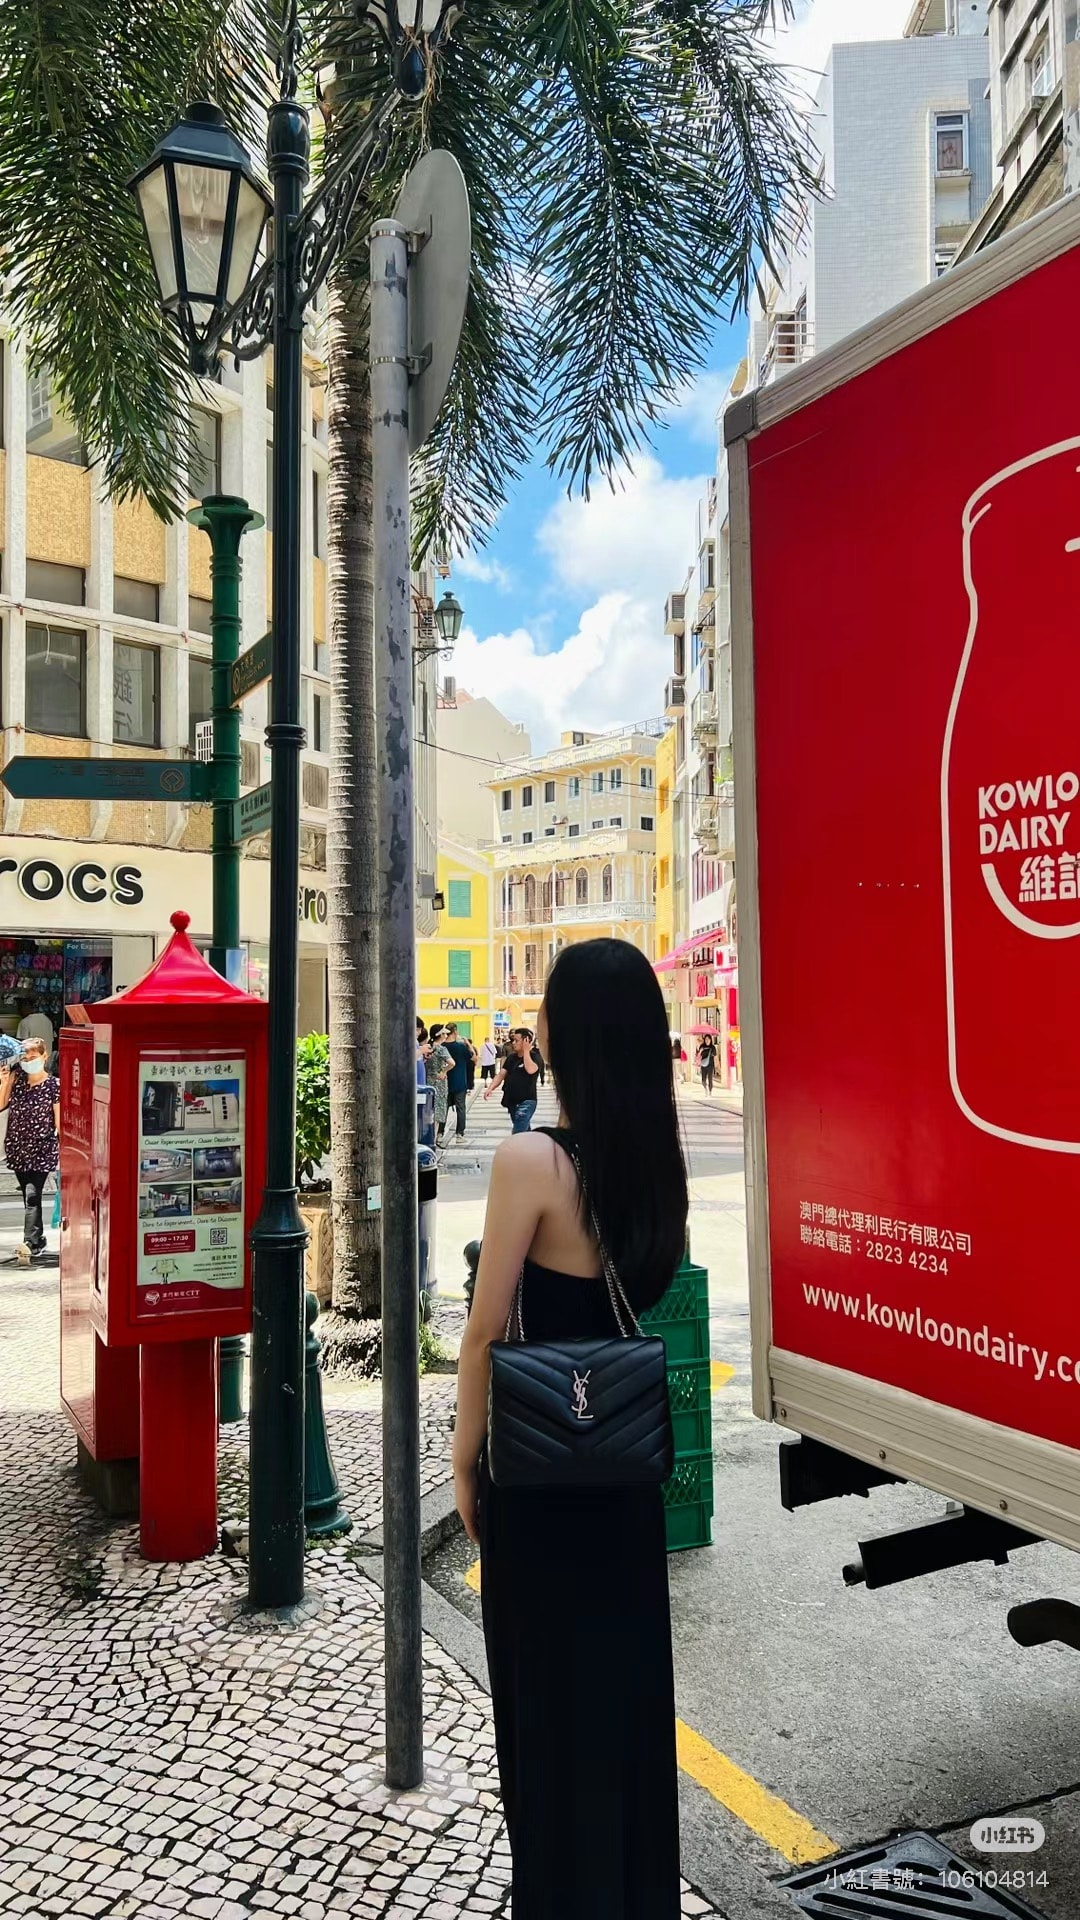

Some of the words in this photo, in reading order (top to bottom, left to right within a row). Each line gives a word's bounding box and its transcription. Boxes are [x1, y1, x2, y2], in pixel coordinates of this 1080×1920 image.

[978, 771, 1080, 819] KOWLO
[979, 811, 1071, 855] DAIRY
[440, 997, 480, 1010] FANCL
[799, 1200, 972, 1256] 澳門總代理利民行有限公司
[908, 1251, 949, 1276] 4234
